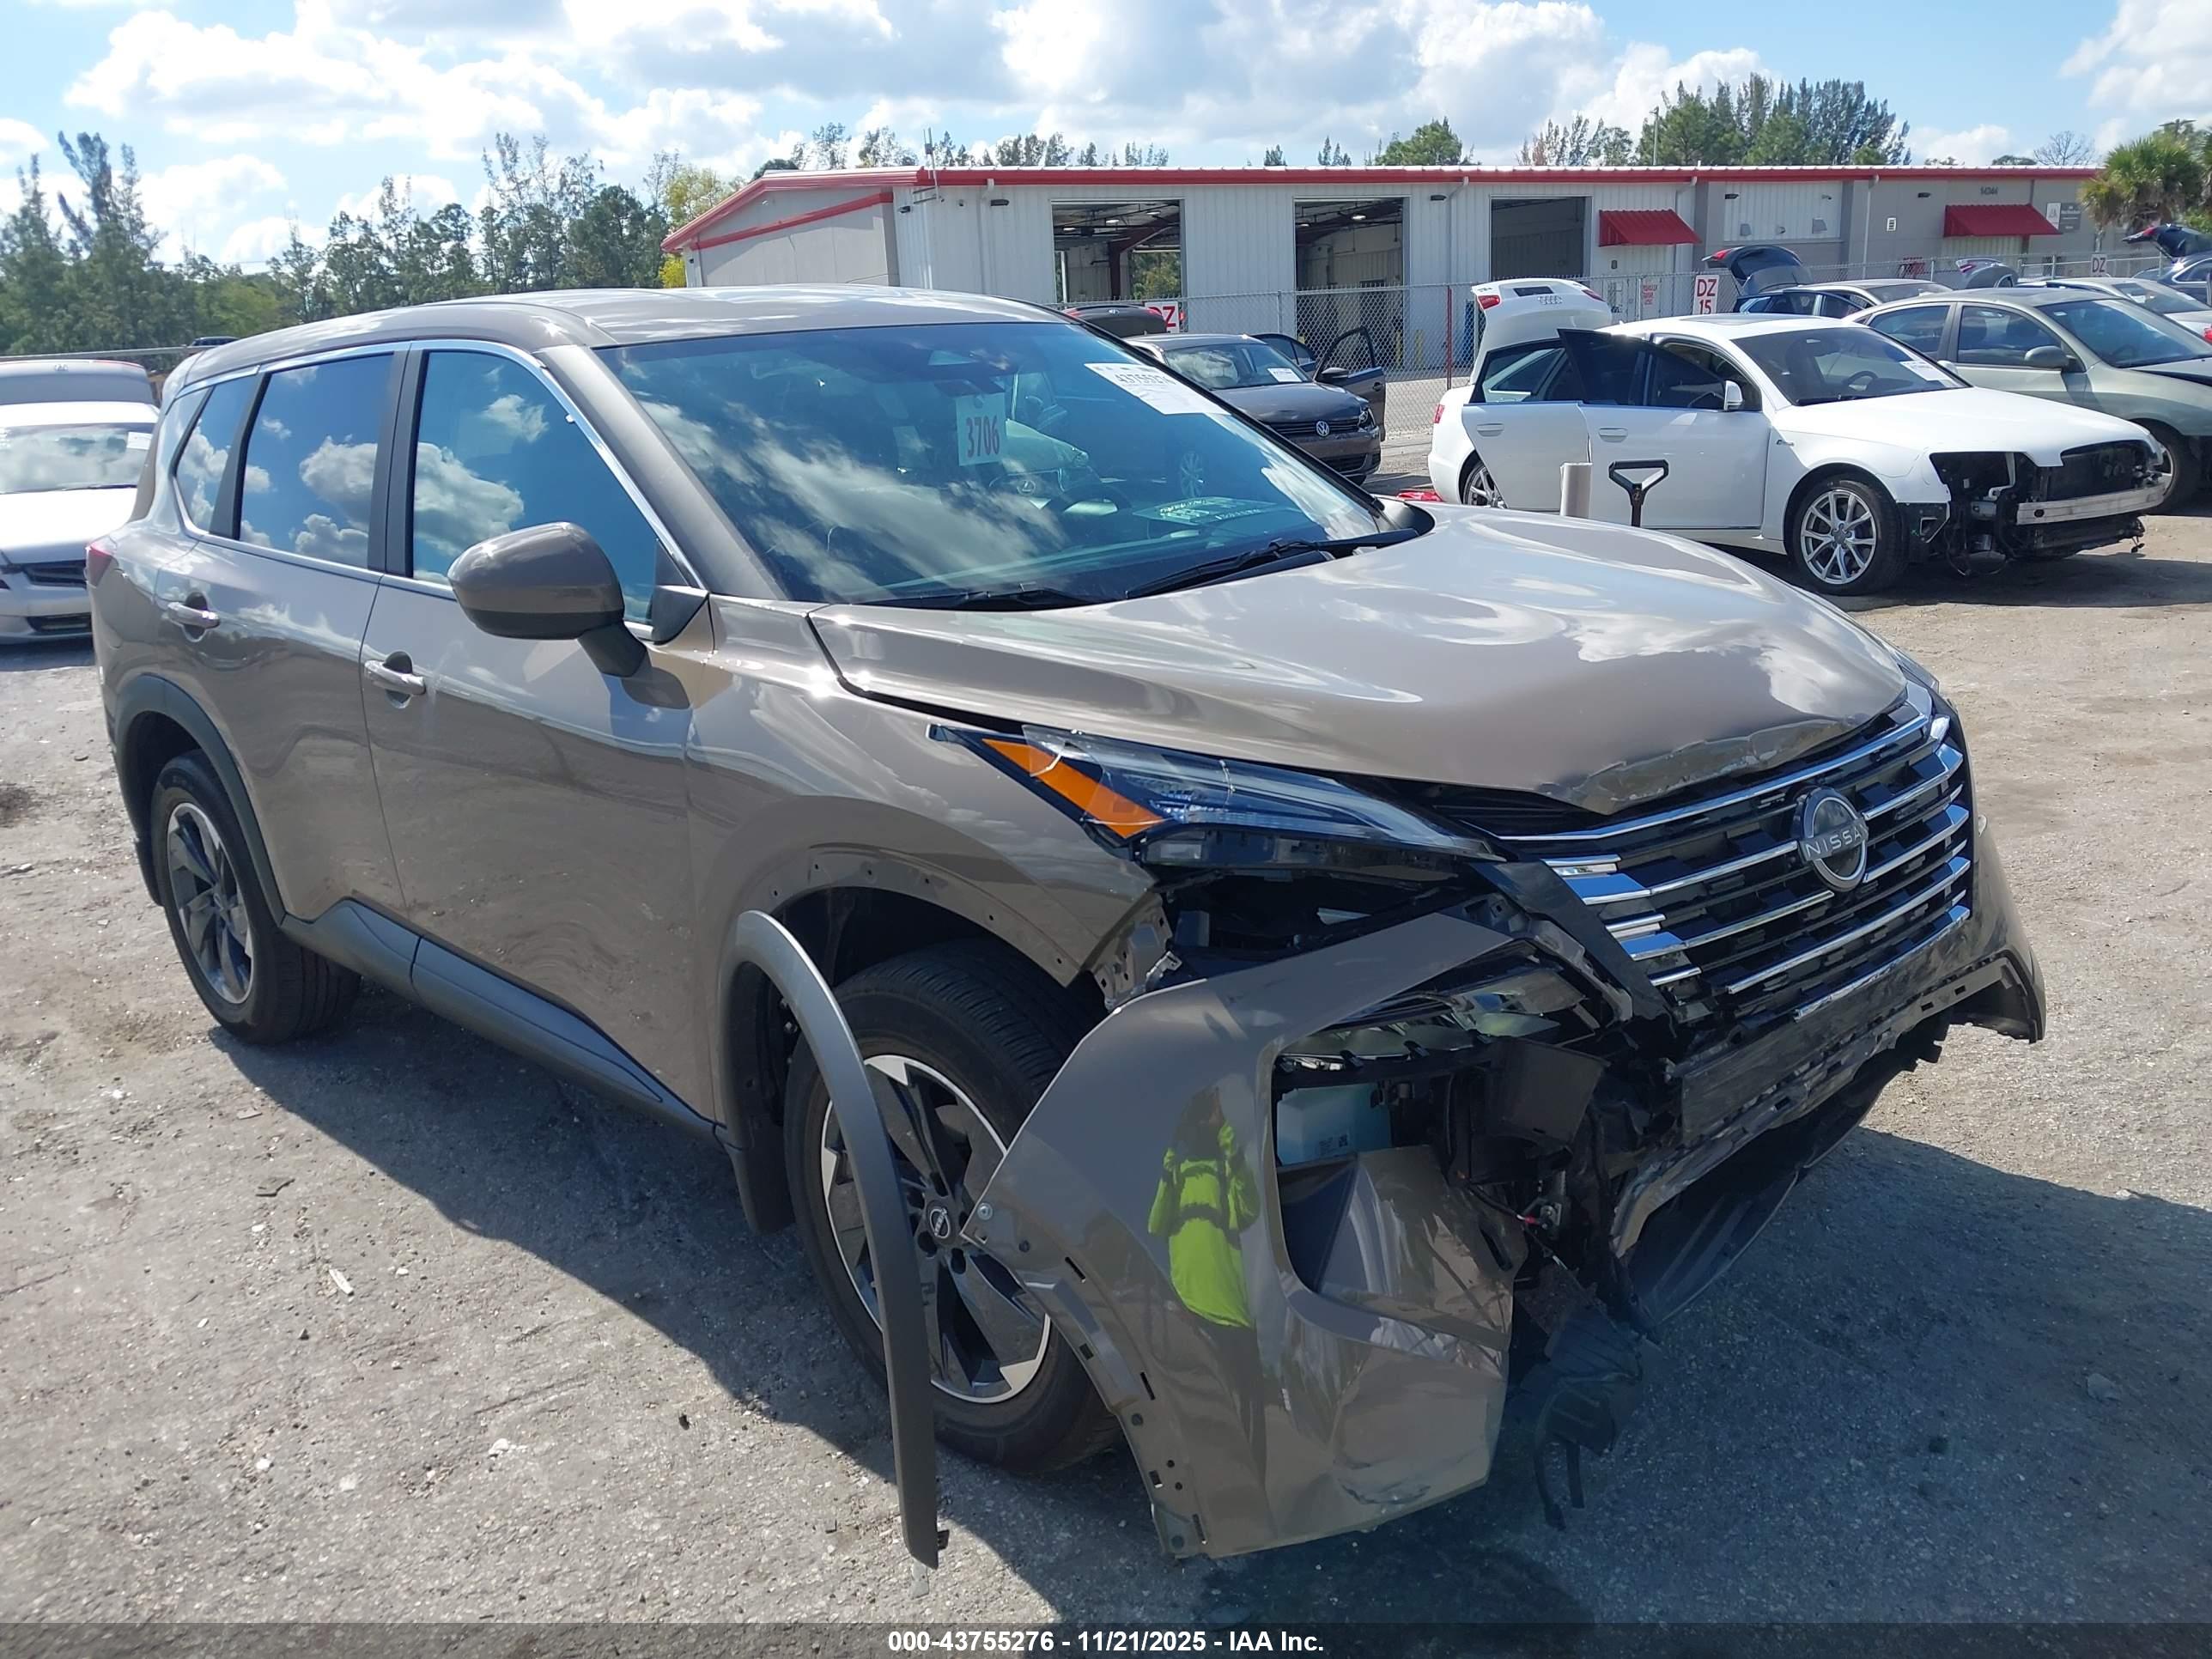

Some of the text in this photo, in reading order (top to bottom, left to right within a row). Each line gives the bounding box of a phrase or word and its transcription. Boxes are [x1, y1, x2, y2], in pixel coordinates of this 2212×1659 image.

[2093, 257, 2106, 273] DZ
[1697, 278, 1717, 297] DZ
[1698, 299, 1712, 315] 15
[966, 415, 1000, 459] 3706
[1805, 823, 1868, 858] NISSAN
